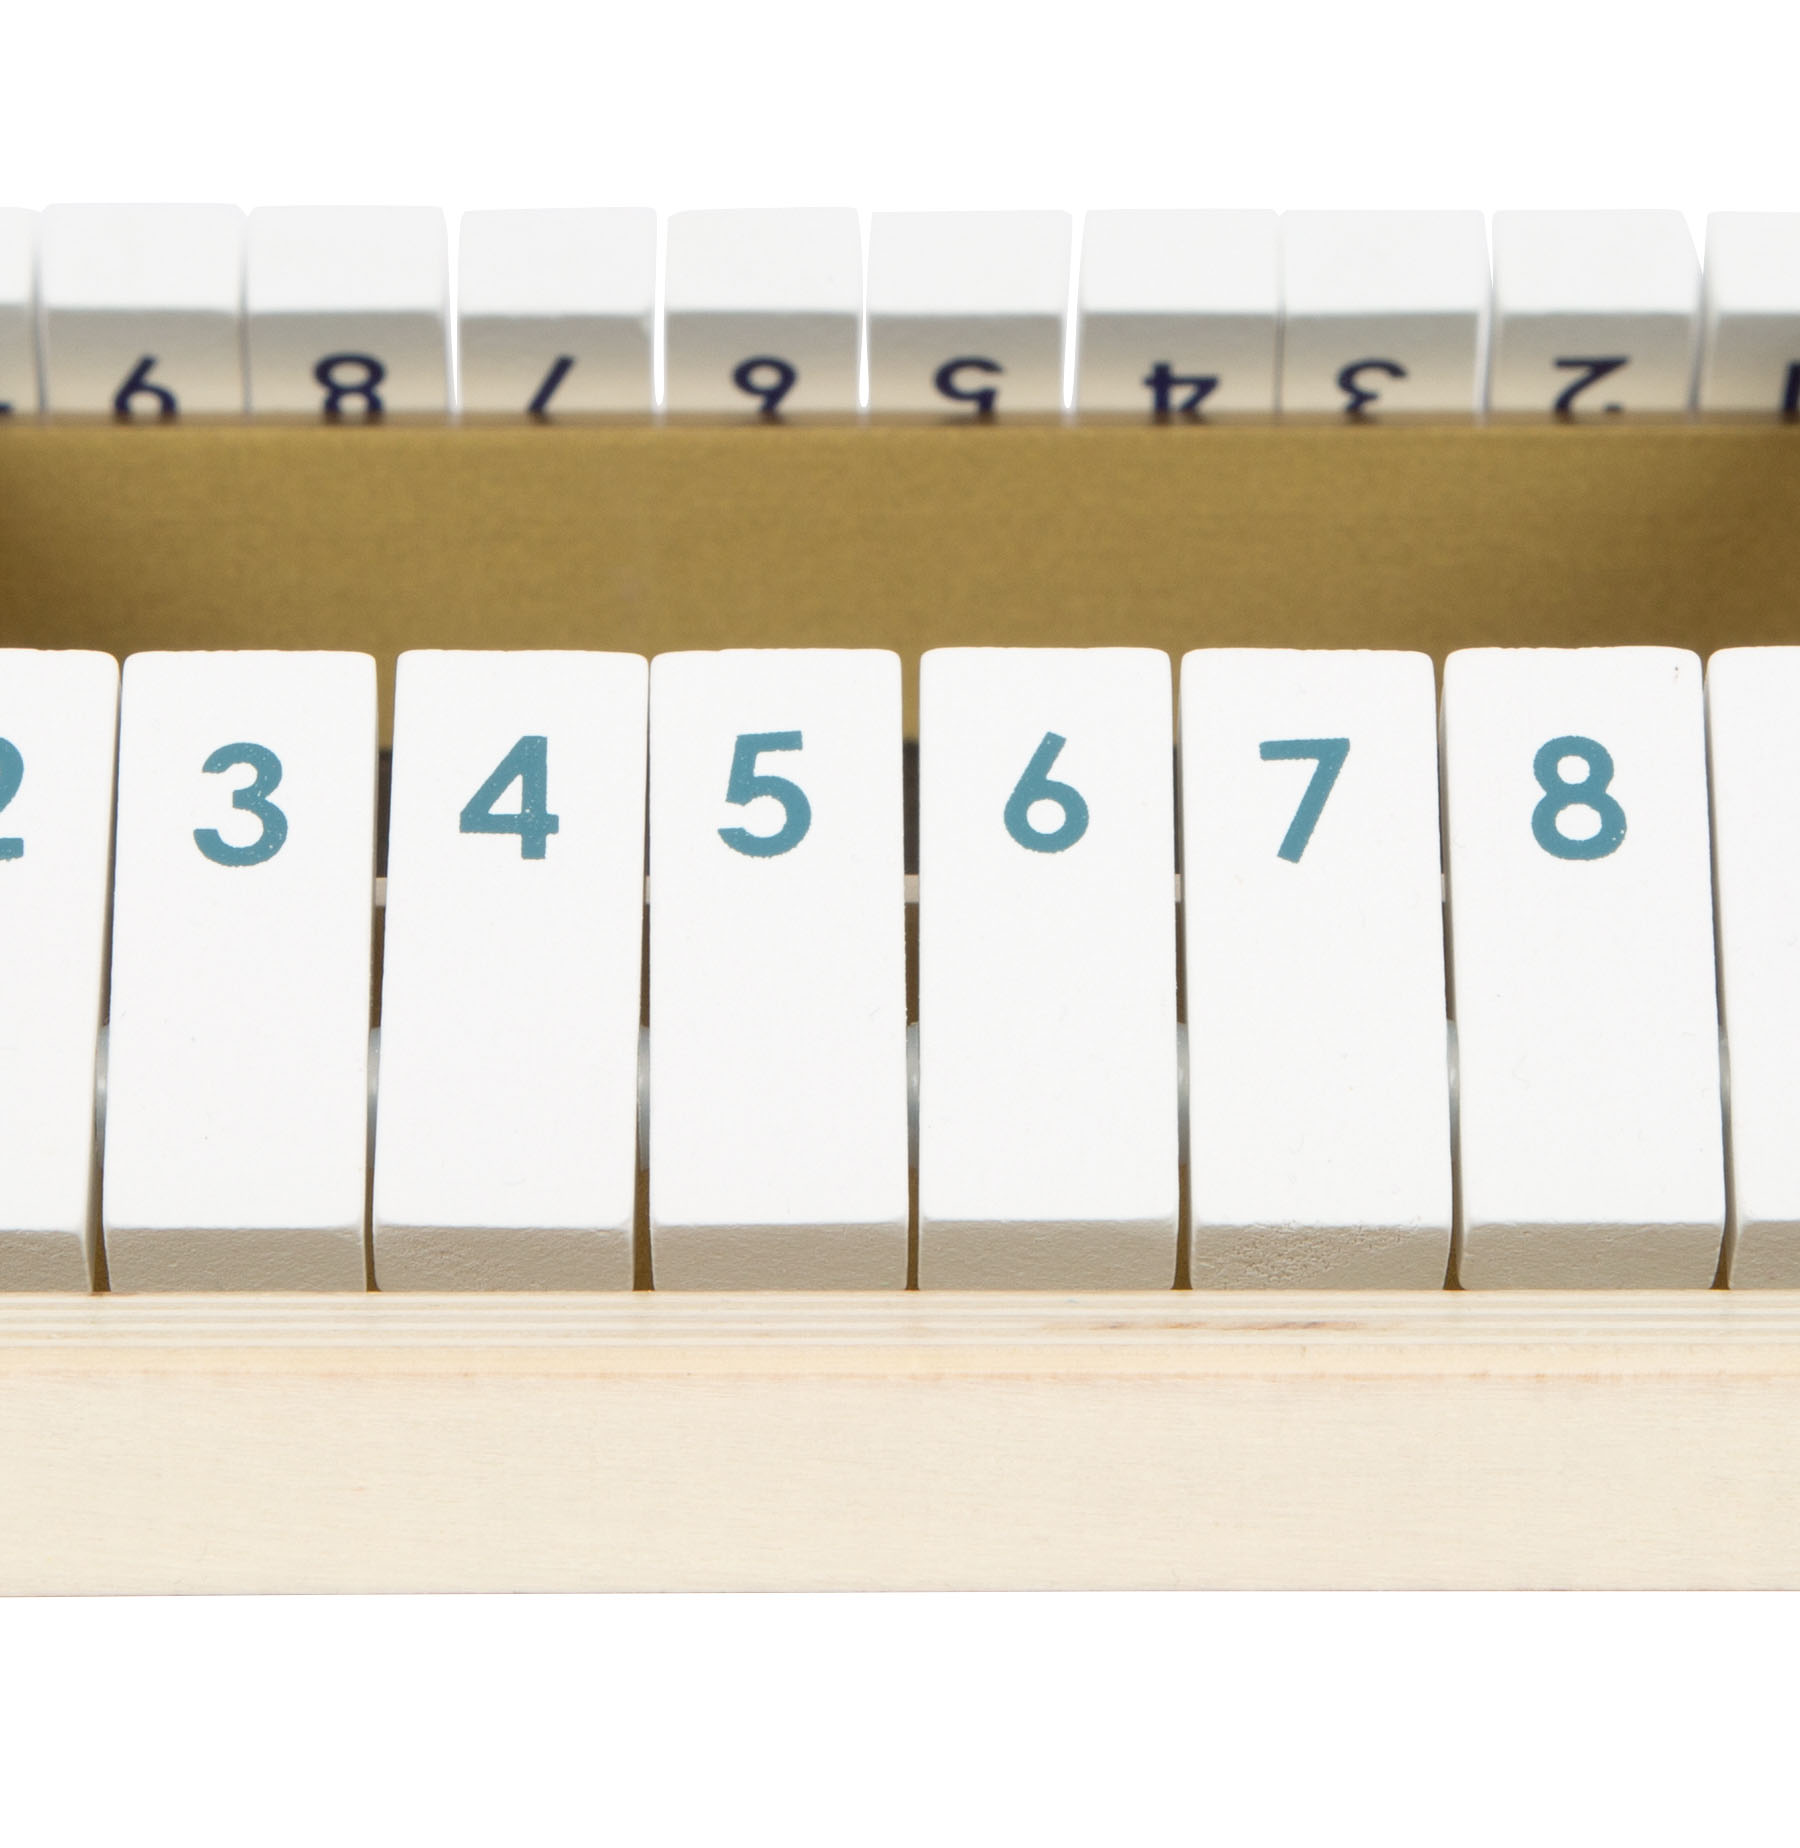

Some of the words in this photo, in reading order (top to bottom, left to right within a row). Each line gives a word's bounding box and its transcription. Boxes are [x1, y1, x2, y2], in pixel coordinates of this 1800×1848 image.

[314, 352, 386, 416] 8
[733, 355, 798, 415] 6
[933, 356, 1000, 416] 5
[1143, 360, 1219, 416] 4
[194, 742, 290, 866] 3
[457, 735, 560, 859] 4
[719, 731, 811, 858] 5
[1004, 731, 1090, 857] 6
[1261, 738, 1350, 862] 7
[1529, 734, 1627, 861] 8
